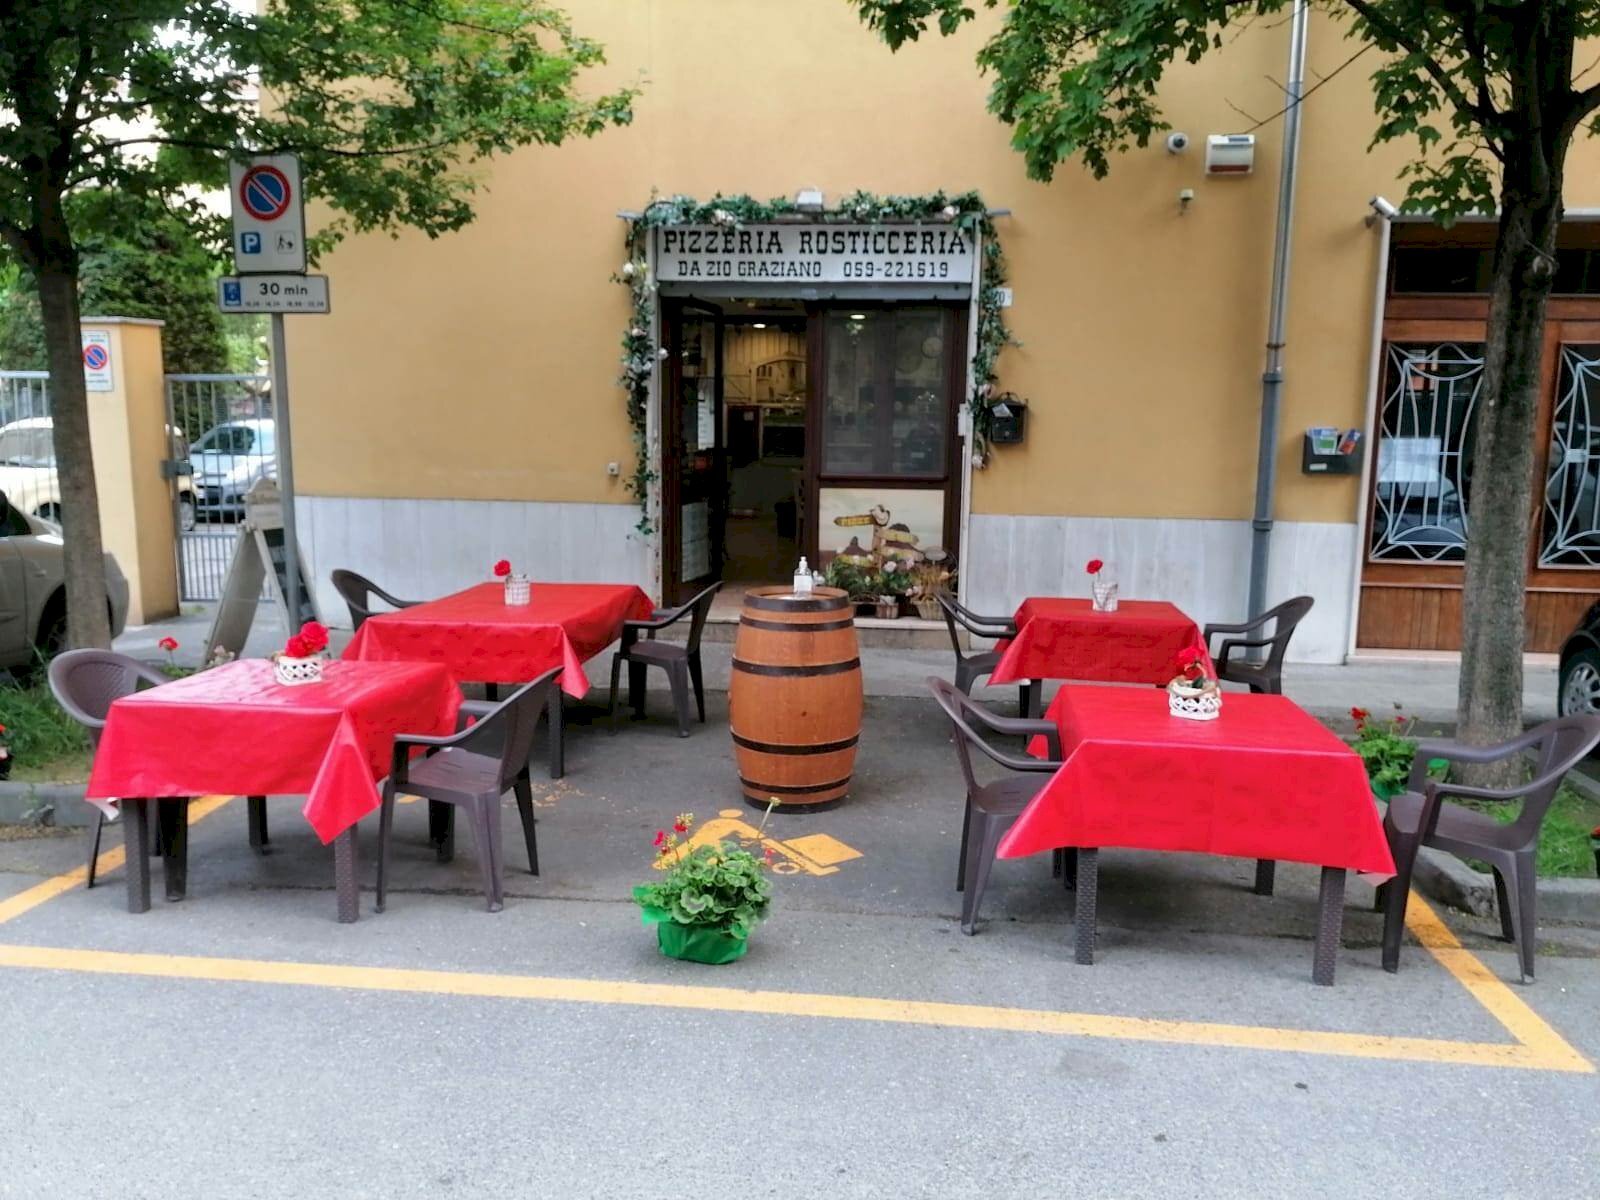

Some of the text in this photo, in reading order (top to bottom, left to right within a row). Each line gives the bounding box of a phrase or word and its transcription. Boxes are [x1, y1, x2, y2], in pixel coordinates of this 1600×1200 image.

[244, 233, 259, 252] P
[663, 230, 967, 255] PIZZERIA ROSTICCERIA
[678, 260, 948, 277] DA ZIO GRAZIANO 059-221519
[259, 282, 308, 296] 30 min
